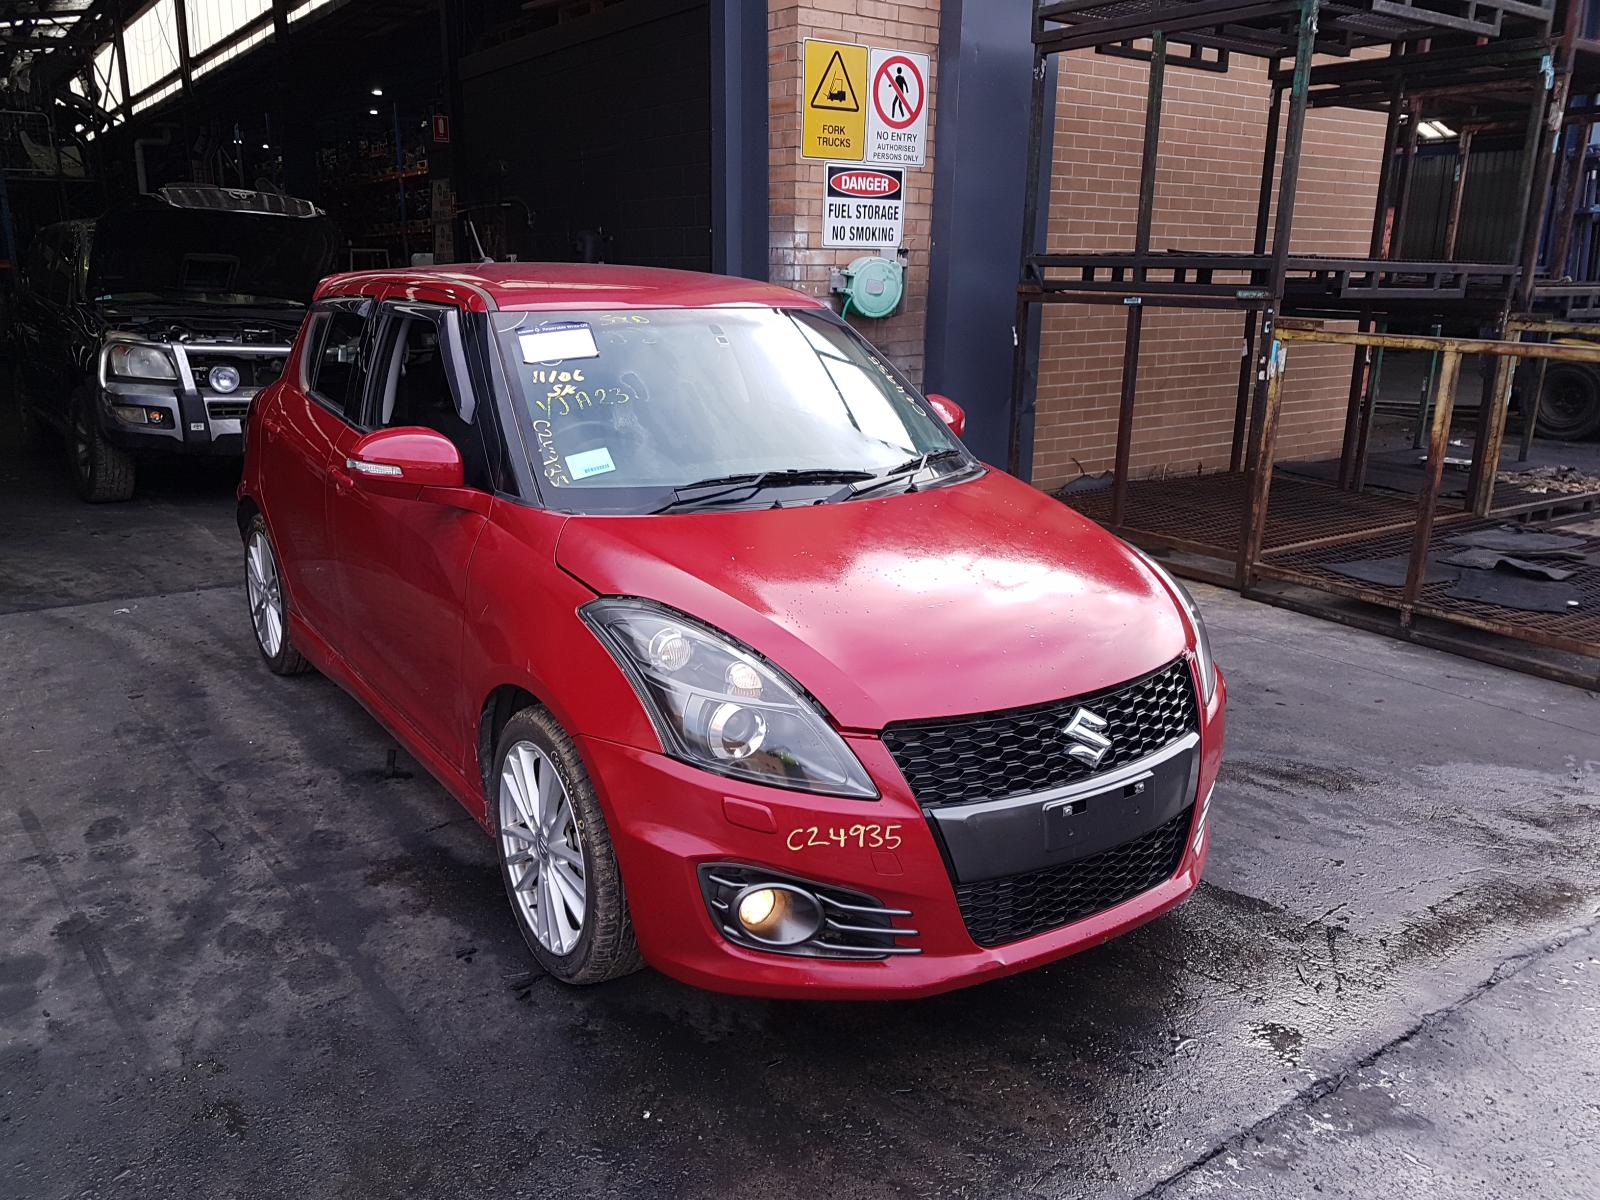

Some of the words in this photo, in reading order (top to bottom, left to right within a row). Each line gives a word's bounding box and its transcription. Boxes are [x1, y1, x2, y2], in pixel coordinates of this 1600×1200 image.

[822, 124, 846, 135] FORK
[817, 136, 851, 148] TRUCKS
[876, 131, 889, 141] NO
[891, 132, 918, 143] ENTRY
[877, 143, 916, 153] AUTHORISED
[873, 152, 902, 161] PERSONS
[903, 154, 919, 162] ONLY
[841, 175, 889, 192] DANGER
[828, 203, 852, 219] FUEL
[856, 204, 899, 220] STORAGE
[832, 225, 846, 241] NO
[849, 226, 894, 242] SMOKING
[786, 824, 902, 851] C24935
